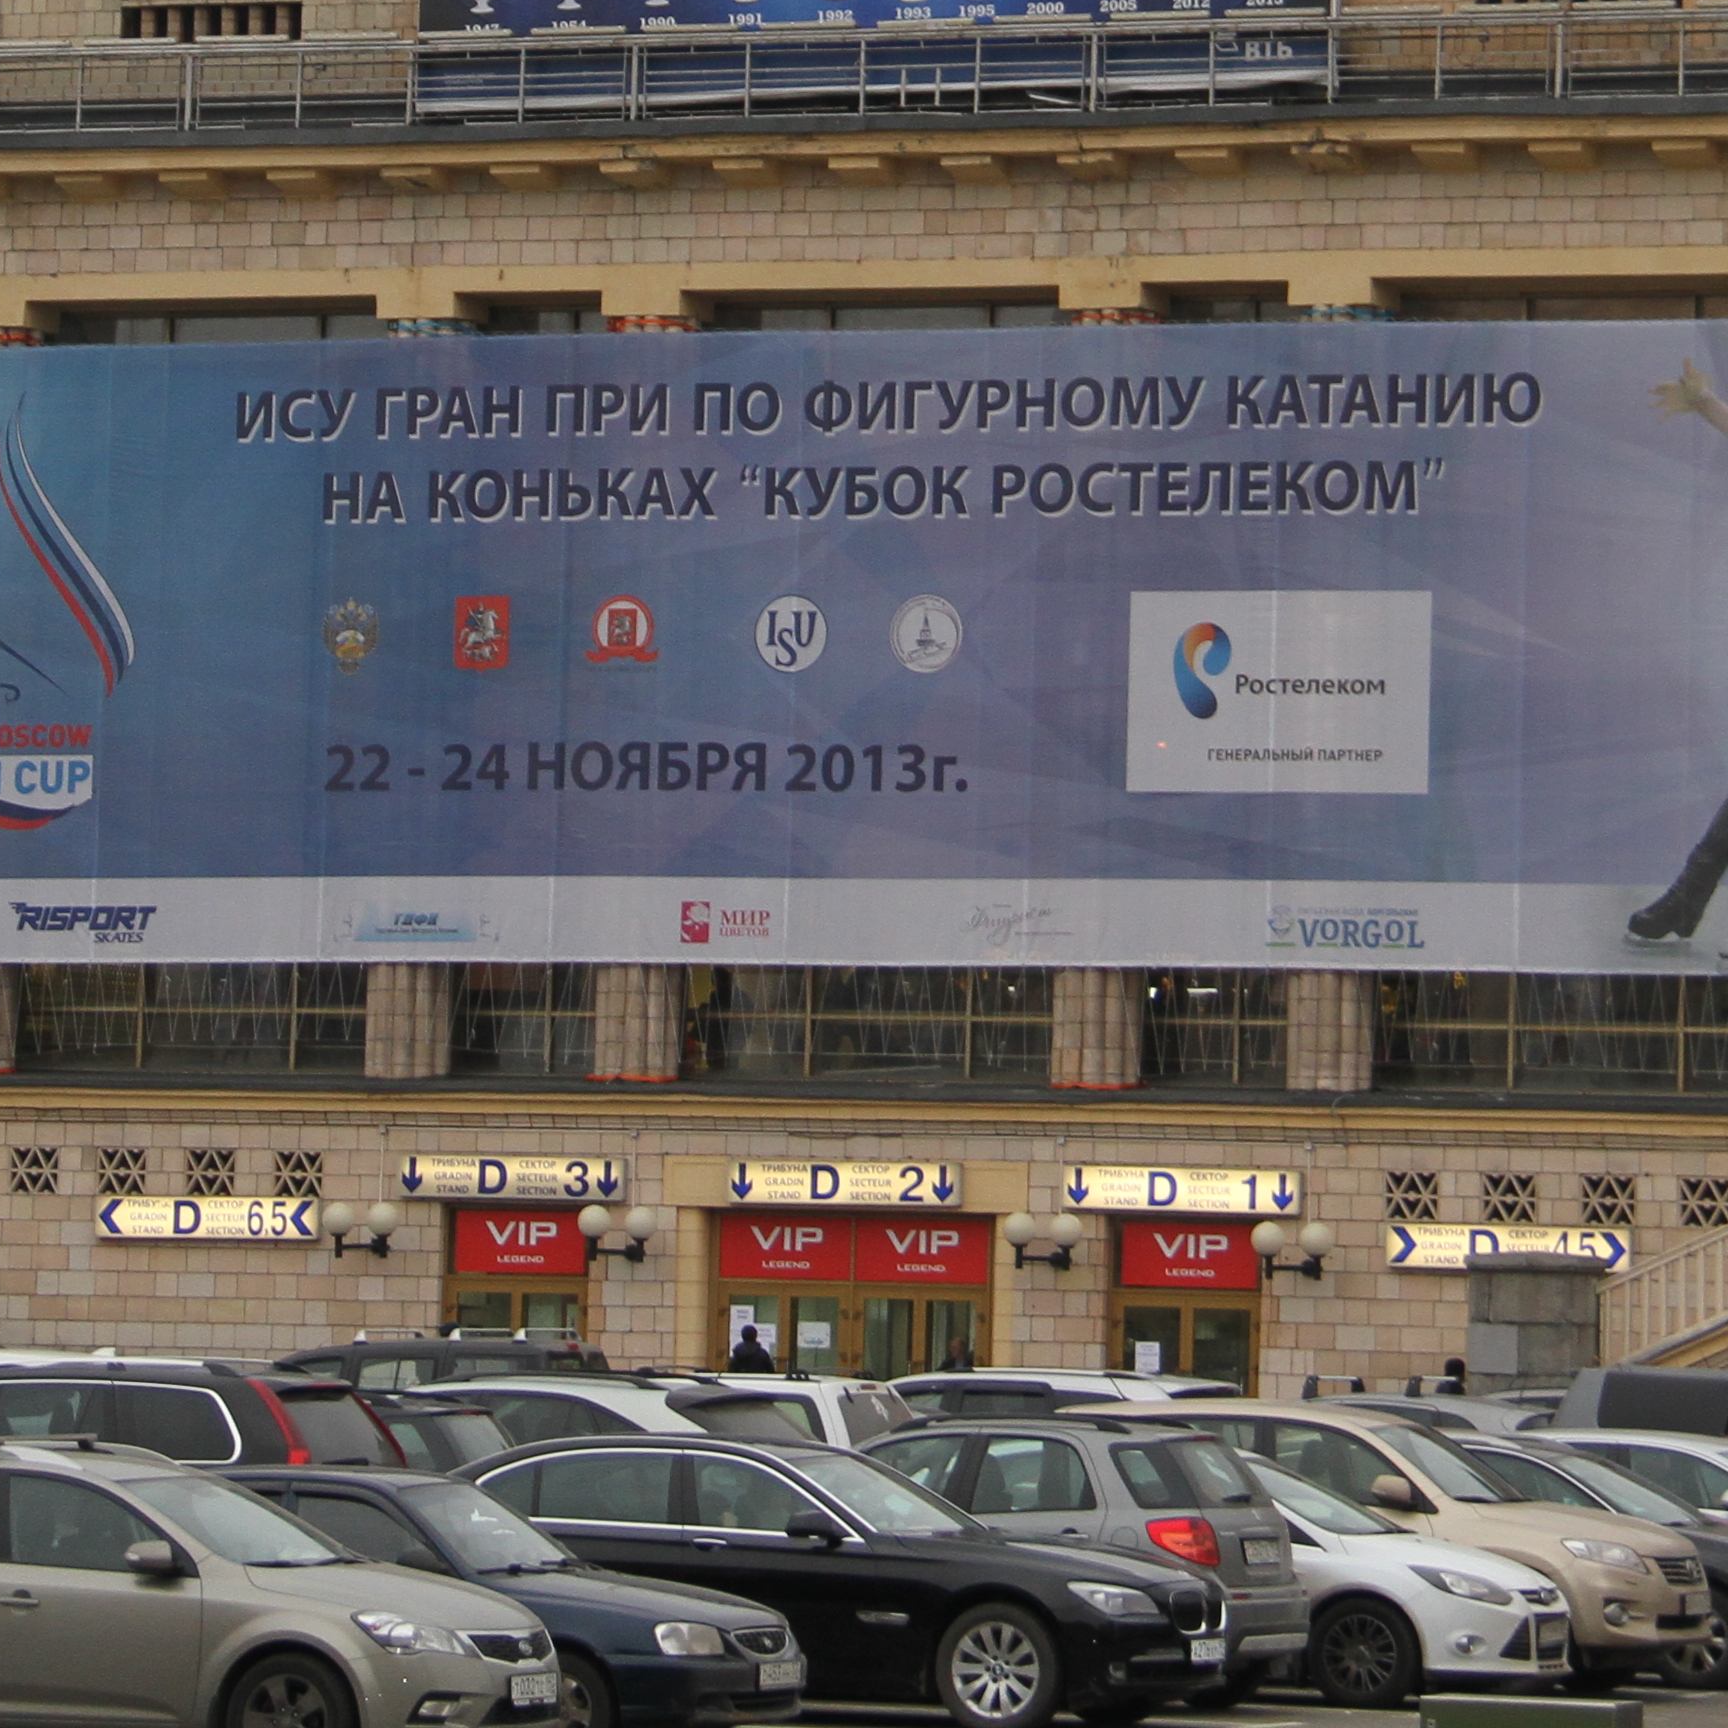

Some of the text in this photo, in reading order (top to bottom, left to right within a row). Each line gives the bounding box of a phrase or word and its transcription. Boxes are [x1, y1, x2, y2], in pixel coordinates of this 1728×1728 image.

[639, 16, 676, 28] 1990
[728, 12, 763, 26] 1991
[817, 9, 854, 23] 1992
[894, 5, 932, 20] 1993
[958, 3, 996, 17] 1995
[1026, 0, 1065, 15] 2000
[236, 372, 1543, 442] ИСУ ГРАН ПРИ ПО ФИГУРНОМУ КАТАНИЮ
[323, 471, 406, 525] НА
[429, 466, 719, 522] КОНЬКАХ
[1235, 674, 1386, 696] Ростелеком
[1207, 747, 1384, 763] ГЕНЕРАЛЬНЫЙ ПАРТНЕР
[324, 745, 391, 793] 22
[442, 744, 508, 792] 24
[527, 741, 768, 793] НОЯБРЯ
[784, 744, 969, 794] 2013г.
[14, 759, 92, 795] CUP
[8, 902, 157, 932] RISPORT
[720, 909, 771, 926] МИР
[719, 927, 770, 936] ЦВЕТОВ
[1297, 918, 1425, 948] VORGOL
[93, 931, 144, 943] SKATES
[431, 1158, 476, 1168] ТРИБУНА
[519, 1160, 556, 1169] СЕКТОР
[761, 1163, 808, 1173] ТРИБУНА
[851, 1164, 890, 1174] СЕКТОР
[1098, 1169, 1145, 1178] ТРИБУНА
[434, 1171, 472, 1181] GRADIN
[477, 1159, 507, 1194] D
[516, 1173, 558, 1183] SECTEUR
[564, 1161, 589, 1197] 3
[765, 1176, 804, 1186] GRADIN
[1190, 1172, 1229, 1181] СЕКТОР
[809, 1164, 840, 1200] D
[849, 1178, 892, 1188] SECTEUR
[899, 1166, 924, 1202] 2
[436, 1184, 469, 1194] STAND
[516, 1186, 557, 1196] SECTION
[1101, 1183, 1141, 1192] GRADIN
[1147, 1171, 1177, 1206] D
[1187, 1185, 1230, 1195] SECTEUR
[1241, 1174, 1257, 1210] 1
[767, 1190, 801, 1200] STAND
[849, 1191, 891, 1201] SECTION
[126, 1199, 171, 1208] ТРИБУ
[207, 1200, 245, 1209] СЕКТОР
[1104, 1196, 1138, 1206] STAND
[1187, 1199, 1230, 1209] SECTION
[130, 1212, 167, 1221] GRADIN
[173, 1200, 201, 1234] D
[205, 1212, 245, 1222] SECTEUR
[131, 1225, 165, 1235] STAND
[205, 1226, 245, 1235] SECTION
[485, 1220, 558, 1246] VIP
[1417, 1227, 1466, 1237] ТРИБУНА
[1508, 1229, 1549, 1239] СЕКТОР
[750, 1225, 824, 1252] VIP
[885, 1228, 960, 1255] VIP
[1152, 1232, 1228, 1259] VIP
[1420, 1241, 1462, 1251] GRADIN
[496, 1254, 545, 1263] LEGEND
[1423, 1254, 1459, 1264] STAND
[762, 1259, 811, 1270] LEGEND
[896, 1263, 946, 1273] LEGEND
[1165, 1268, 1215, 1278] LEGEND
